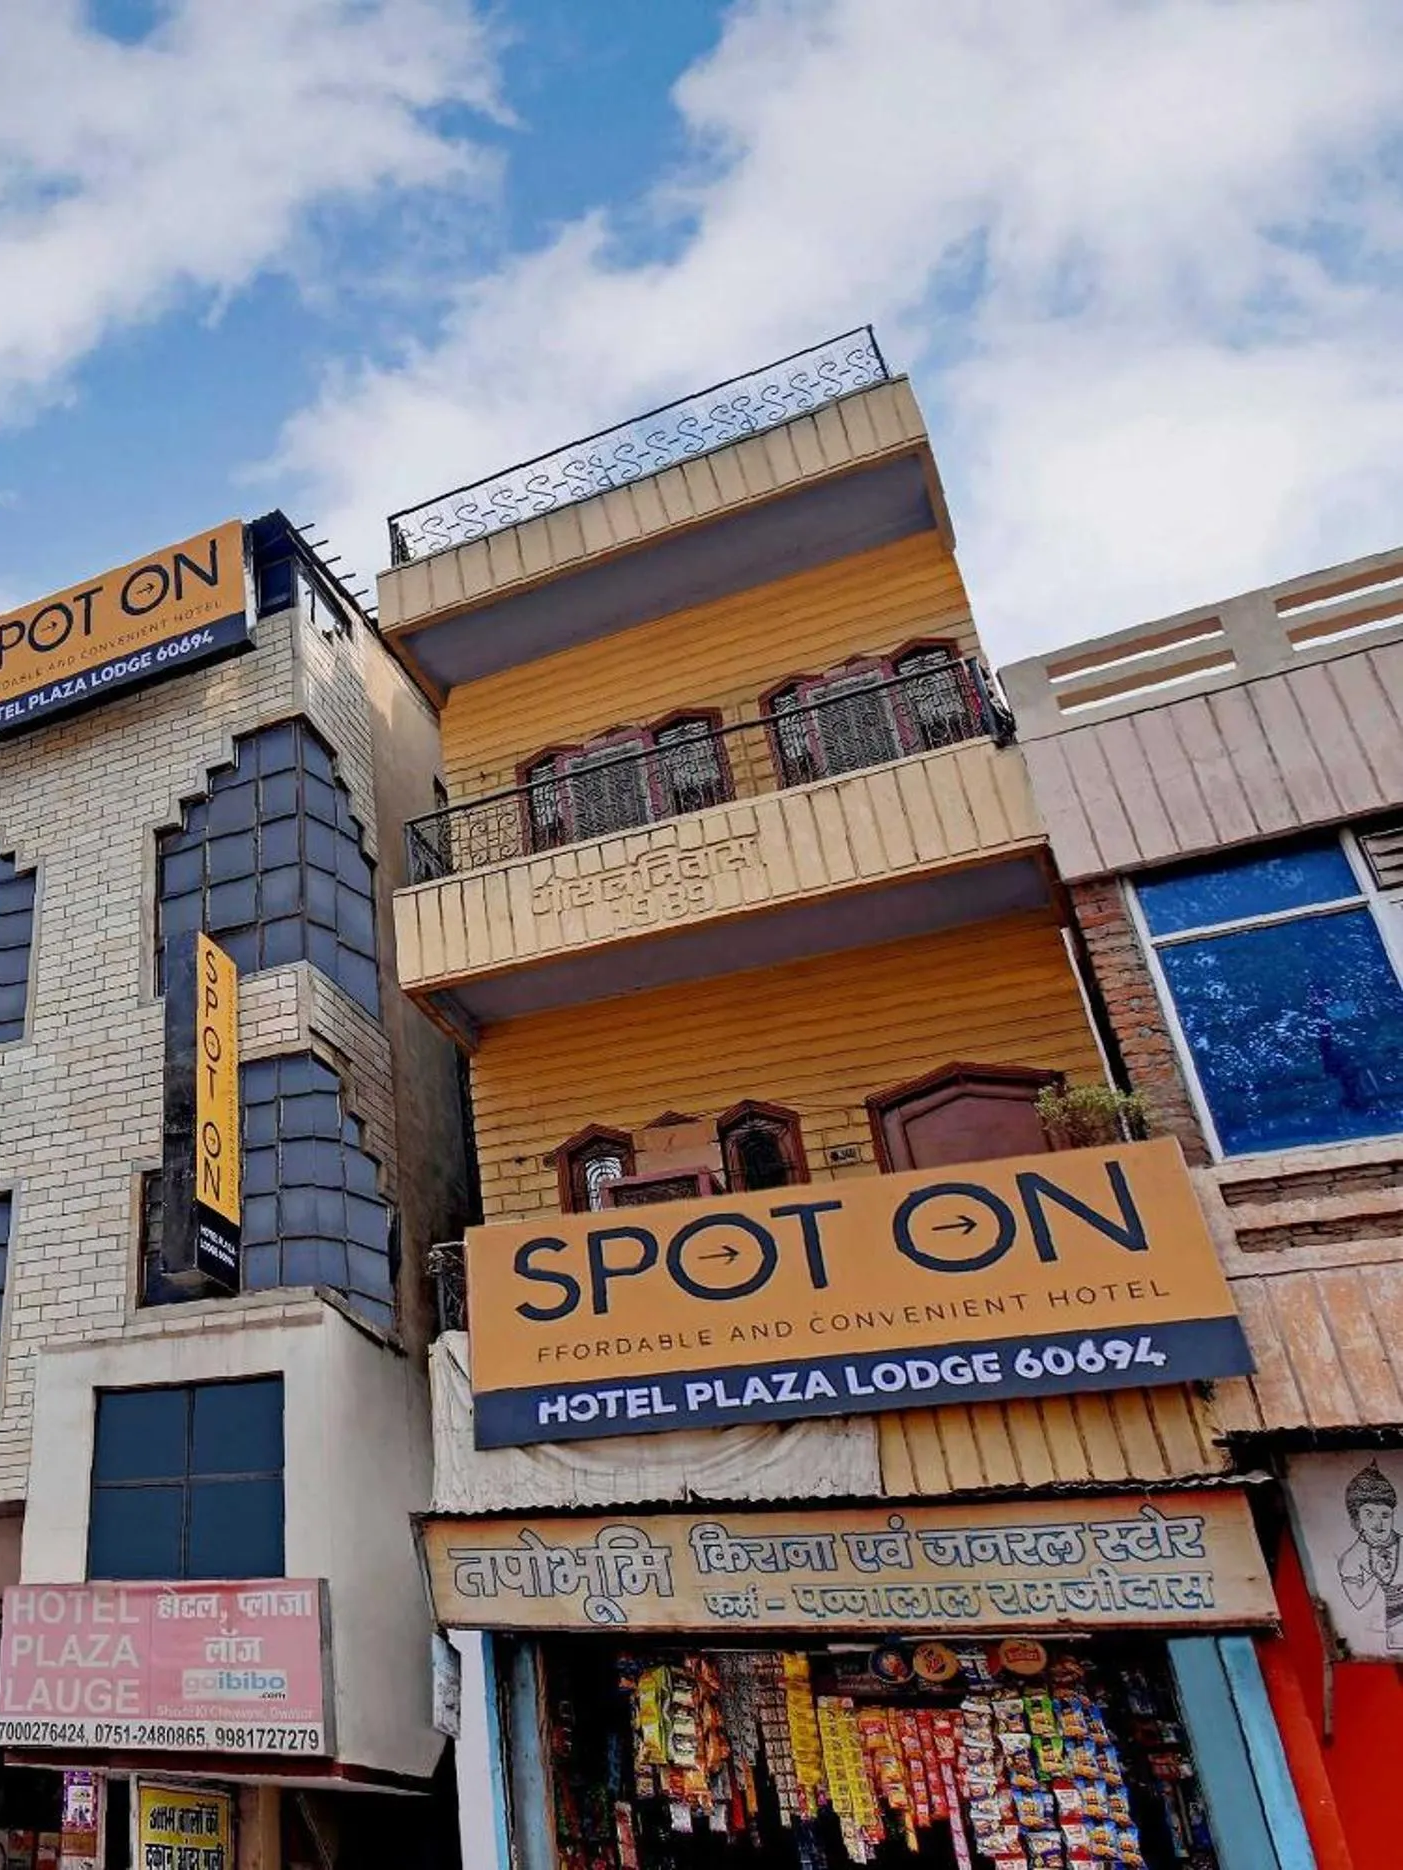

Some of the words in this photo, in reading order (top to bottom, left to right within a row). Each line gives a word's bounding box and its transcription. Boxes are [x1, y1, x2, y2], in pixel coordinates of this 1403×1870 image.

[120, 538, 219, 616] ON
[80, 619, 168, 660] CONVENIENT
[173, 600, 223, 624] HOTEL
[28, 680, 87, 712] PLAZA
[91, 653, 153, 688] LODGE
[157, 628, 215, 662] 60694
[202, 949, 220, 1103] SPOT
[202, 1121, 221, 1202] ON
[513, 1200, 842, 1322] SPOT
[892, 1160, 1149, 1272] ON
[730, 1319, 793, 1345] AND
[809, 1293, 1029, 1335] CONVENIENT
[1048, 1280, 1170, 1309] HOTEL
[538, 1386, 676, 1426] HOTEL
[685, 1369, 836, 1412] PLAZA
[846, 1353, 1002, 1396] LODGE
[1013, 1337, 1167, 1380] 60694
[447, 1524, 674, 1624] तपोभूमि
[689, 1522, 837, 1573] किराना
[842, 1514, 913, 1572] एवं
[917, 1523, 1086, 1568] जनरल
[1090, 1504, 1206, 1561] स्टोर
[11, 1590, 140, 1624] HOTEL
[236, 1590, 313, 1618] प्लाजा
[10, 1634, 140, 1668] PLAZA
[204, 1628, 264, 1664] लॉज
[3, 1678, 141, 1714] LAUGE
[184, 1671, 286, 1695] goibibo
[215, 1727, 319, 1750] 9981727279
